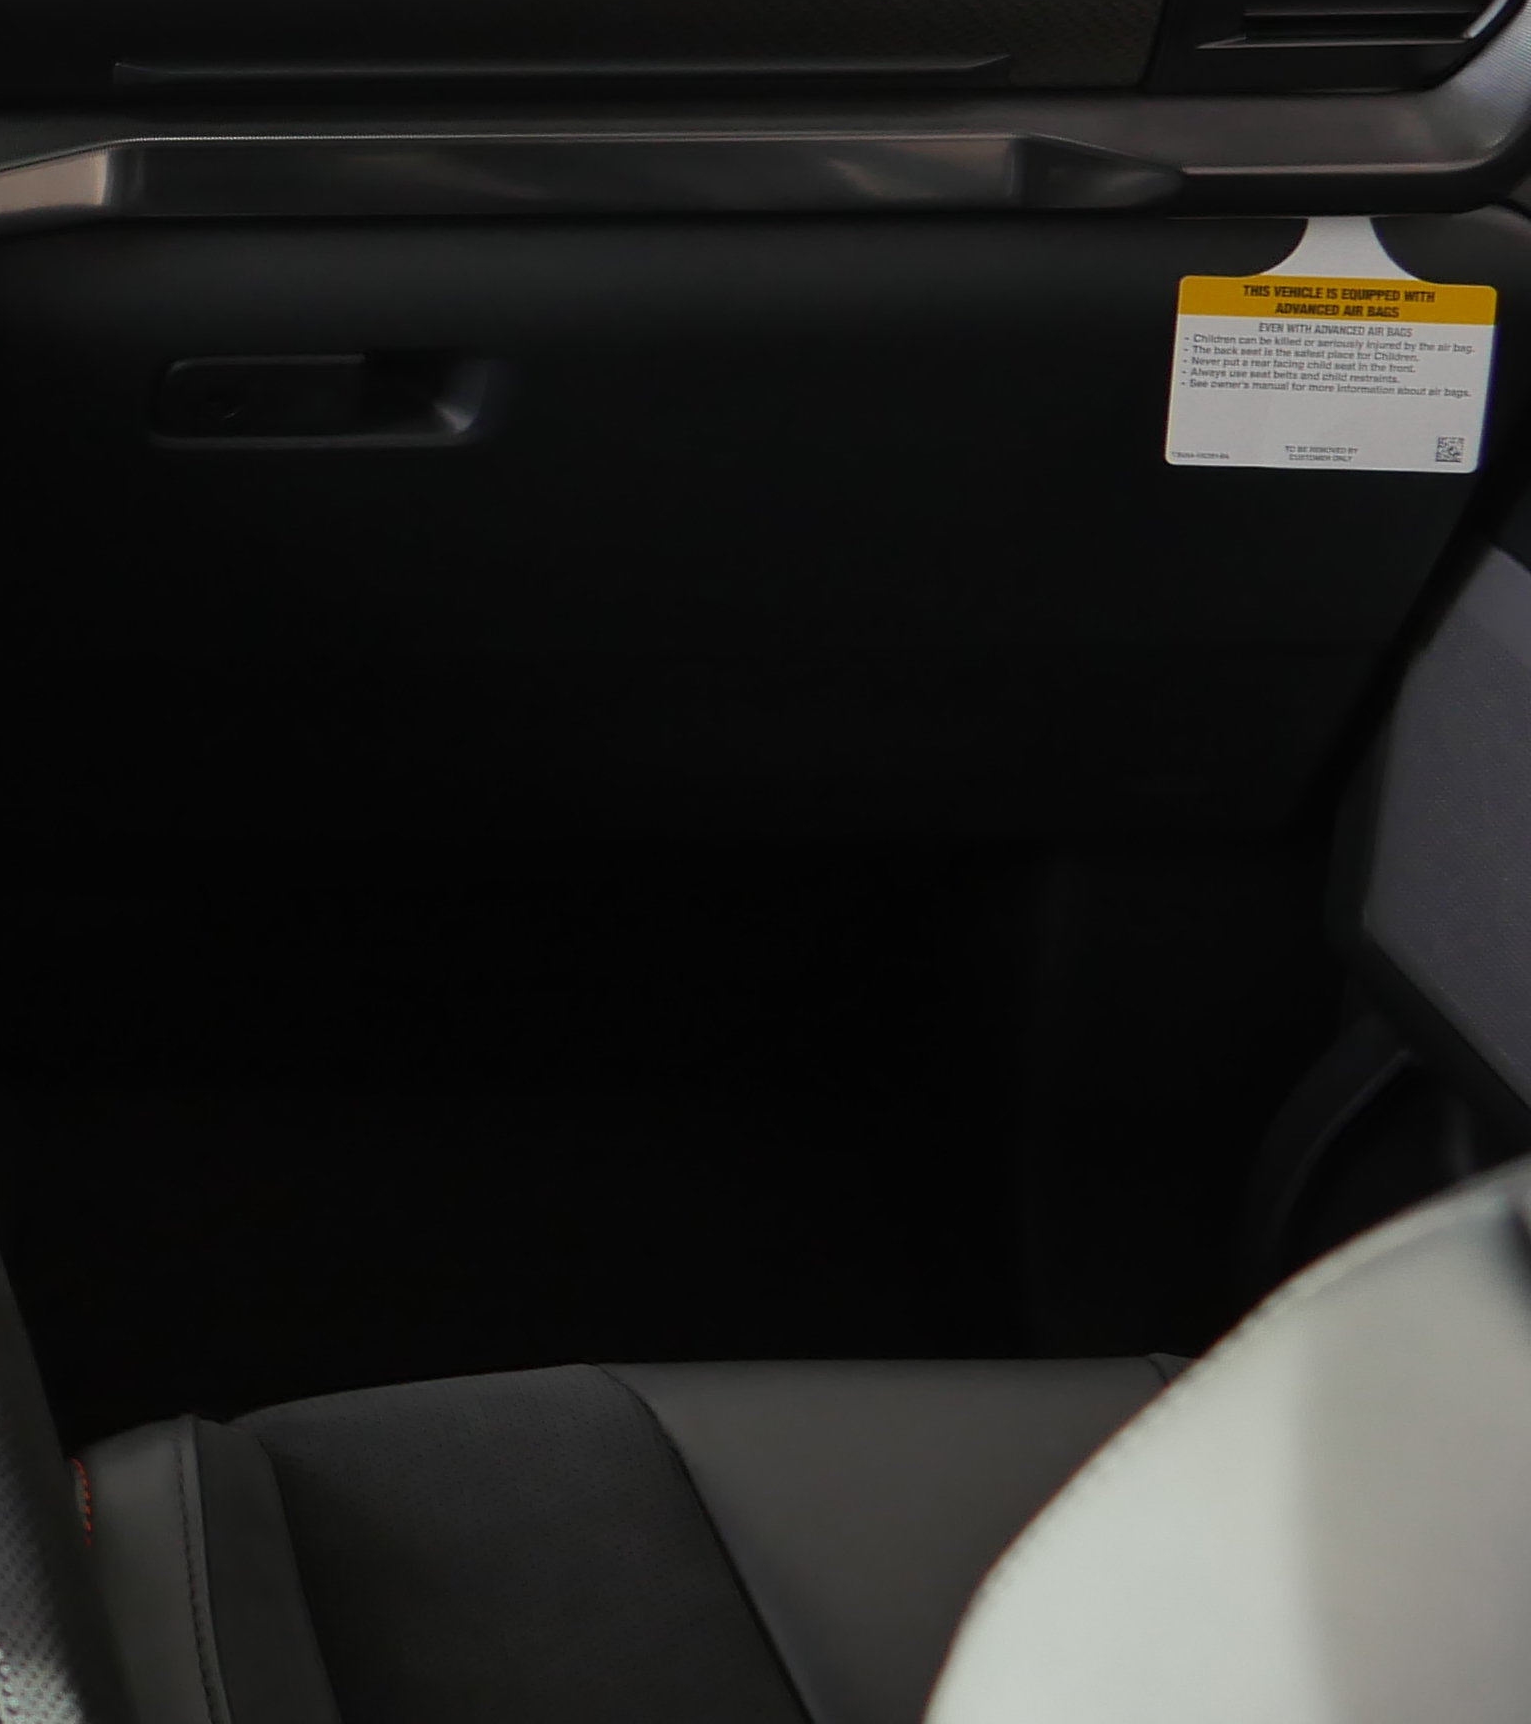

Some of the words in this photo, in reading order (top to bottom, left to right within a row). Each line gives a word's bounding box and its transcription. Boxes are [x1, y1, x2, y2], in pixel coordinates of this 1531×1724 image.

[1243, 285, 1270, 297] THIS
[1274, 286, 1324, 299] VEHICLE
[1326, 288, 1338, 299] IS
[1341, 288, 1401, 301] EQUIPPED
[1404, 290, 1435, 303] WITH
[1275, 303, 1340, 316] ADVANCED
[1343, 305, 1364, 316] AIR
[1367, 306, 1400, 318] BAGS
[1259, 322, 1284, 333] EVEN
[1286, 323, 1311, 334] WITH
[1314, 324, 1365, 336] ADVANCED
[1367, 326, 1384, 336] AIR
[1387, 327, 1413, 337] BAGS
[1193, 334, 1237, 344] Children
[1275, 337, 1301, 346] killed
[1318, 339, 1364, 350] seriously
[1366, 341, 1401, 351] injured
[1419, 342, 1435, 351] the
[1438, 343, 1450, 352] air
[1453, 343, 1475, 355] bag.
[1193, 345, 1211, 354] The
[1214, 346, 1237, 355] back
[1240, 348, 1262, 356] seat
[1275, 348, 1291, 357] the
[1295, 349, 1325, 358] safest
[1327, 350, 1355, 360] place
[1358, 351, 1370, 360] for
[1374, 352, 1419, 362] Children.
[1191, 357, 1220, 365] Never
[1223, 359, 1240, 368] put
[1251, 360, 1270, 368] rear
[1274, 360, 1304, 370] facing
[1307, 361, 1332, 369] child
[1334, 362, 1355, 370] seat
[1371, 363, 1386, 372] the
[1389, 364, 1416, 373] front.
[1190, 367, 1226, 378] Always
[1250, 370, 1271, 378] seat
[1274, 370, 1298, 379] belts
[1300, 371, 1319, 380] and
[1322, 372, 1347, 381] child
[1349, 374, 1400, 383] restraints.
[1189, 379, 1208, 388] See
[1210, 380, 1250, 389] owner's
[1252, 381, 1289, 391] manual
[1292, 382, 1306, 391] for
[1308, 384, 1335, 392] more
[1337, 385, 1395, 395] information
[1397, 387, 1426, 396] about
[1428, 388, 1441, 396] air
[1444, 388, 1472, 398] bags.
